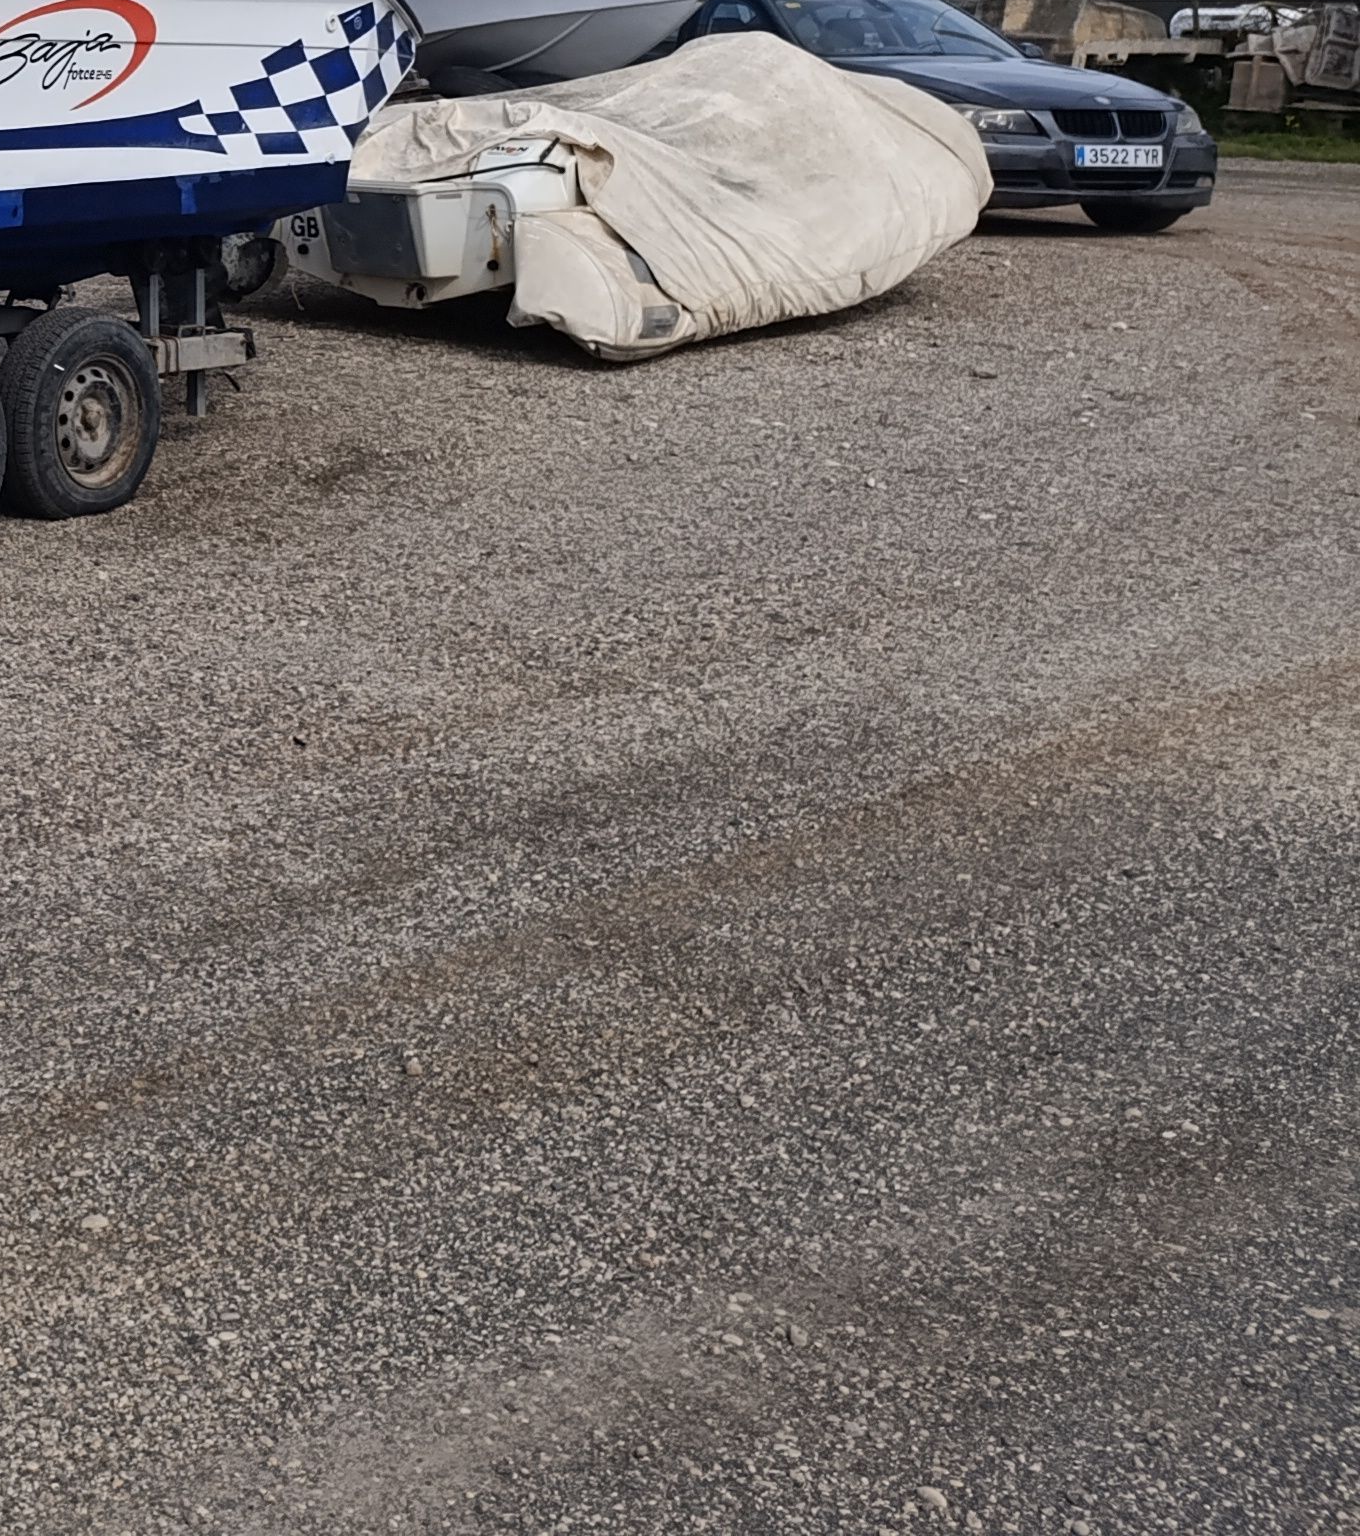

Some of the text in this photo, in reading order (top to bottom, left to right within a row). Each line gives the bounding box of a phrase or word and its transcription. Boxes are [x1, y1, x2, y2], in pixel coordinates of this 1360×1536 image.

[63, 62, 95, 90] force
[1089, 148, 1159, 164] 3522 FYR
[290, 215, 320, 238] GB
